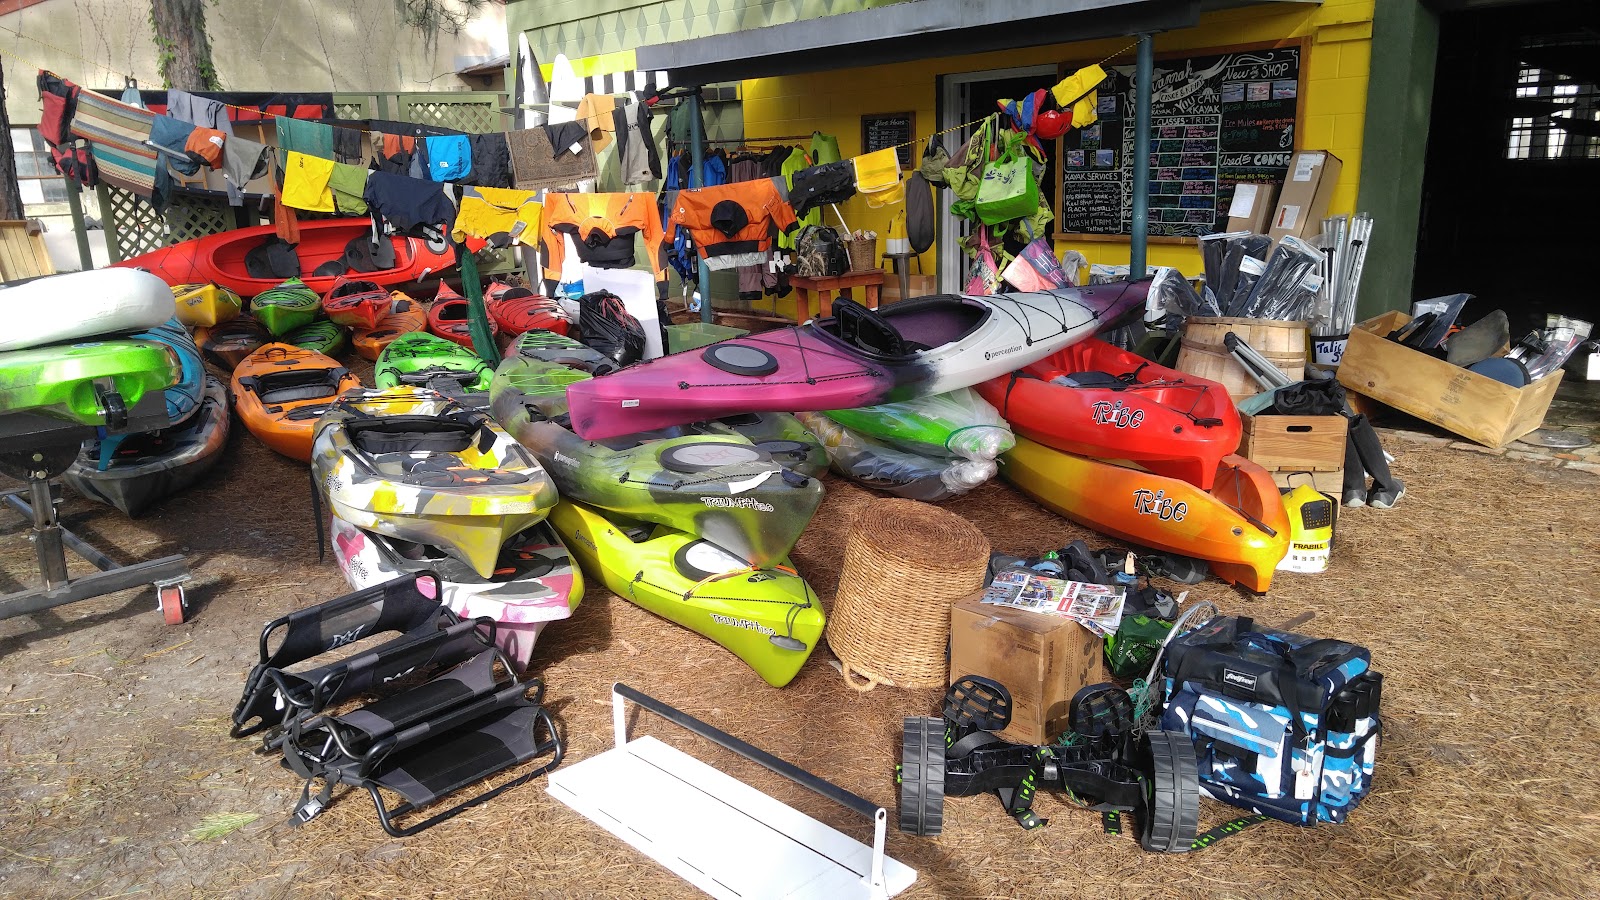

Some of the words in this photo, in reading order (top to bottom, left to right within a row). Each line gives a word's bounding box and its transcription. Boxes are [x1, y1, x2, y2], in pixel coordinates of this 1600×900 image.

[1222, 66, 1248, 81] New
[1261, 63, 1288, 78] SHOP
[1175, 96, 1196, 113] YOU
[1157, 117, 1185, 126] CLASSES
[1190, 116, 1217, 125] TRIPS
[991, 345, 1023, 358] perception
[1293, 542, 1324, 550] FRABILL
